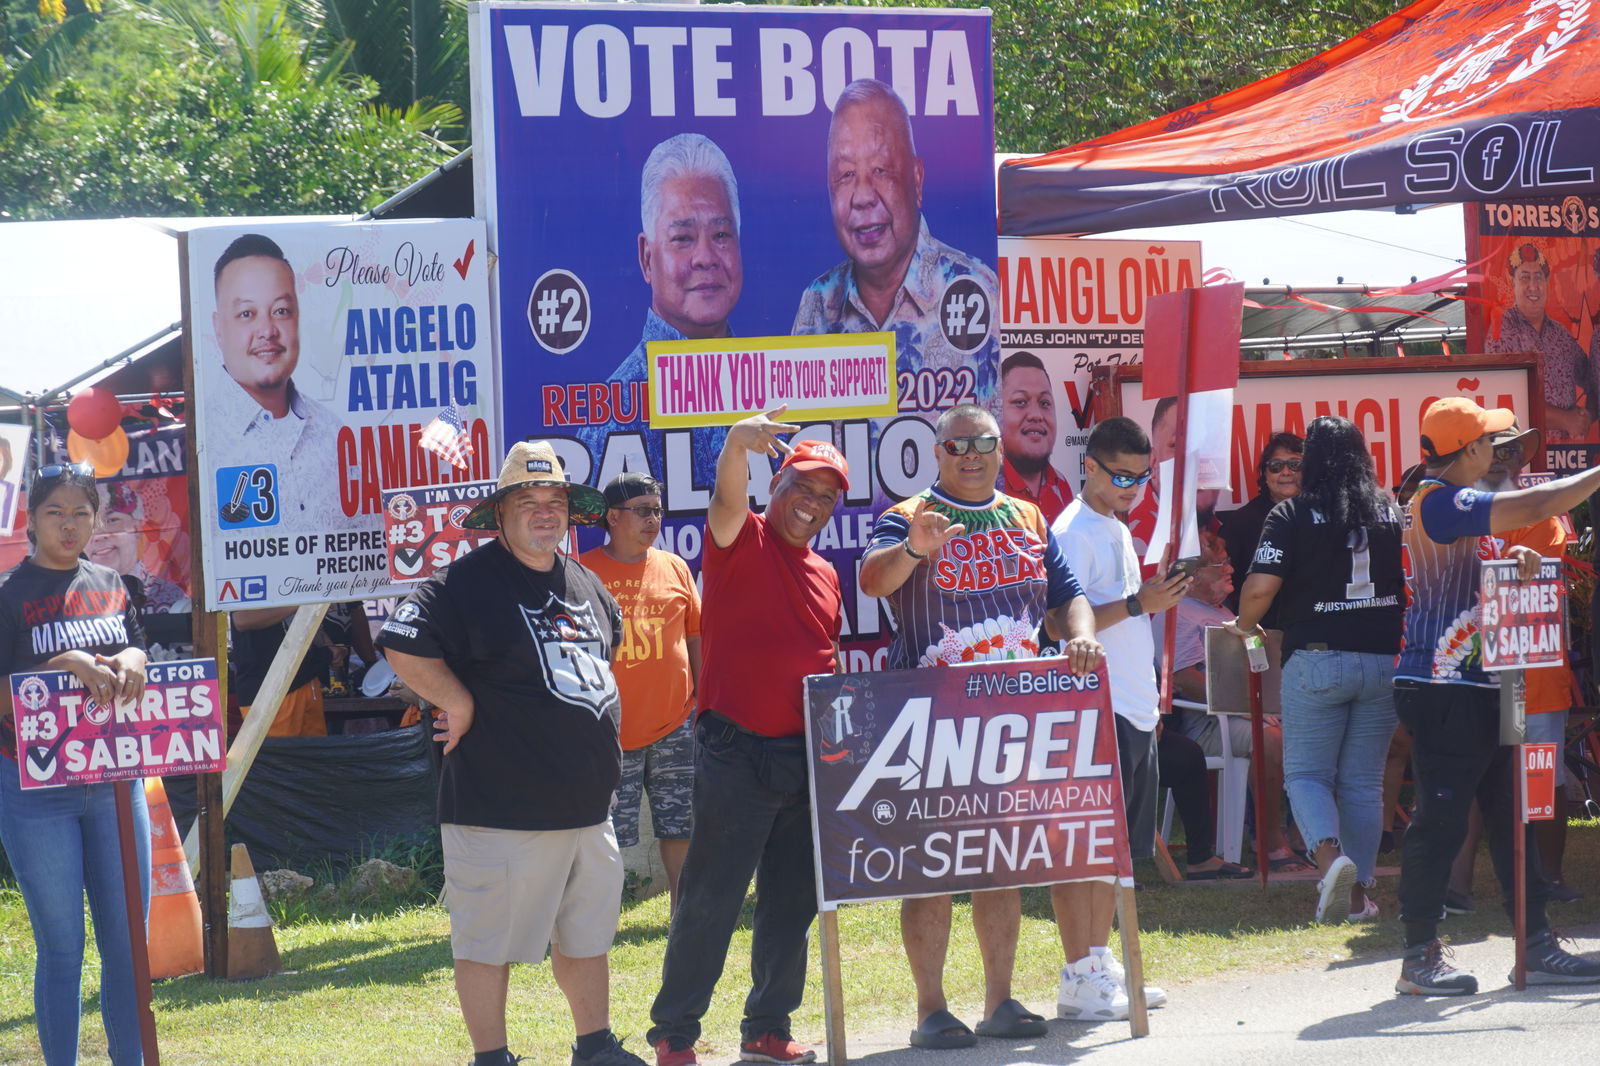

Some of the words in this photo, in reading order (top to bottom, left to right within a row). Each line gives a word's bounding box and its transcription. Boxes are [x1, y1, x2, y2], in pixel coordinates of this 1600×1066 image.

[504, 24, 737, 118] VOTE
[759, 27, 980, 116] BOTA
[1404, 121, 1595, 195] SOIL
[1486, 203, 1562, 228] TORRES
[325, 246, 390, 287] Please
[394, 241, 445, 286] Vote
[538, 288, 583, 335] #2
[946, 292, 986, 336] #2
[345, 303, 476, 355] ANGELO
[1046, 333, 1087, 345] JOHN
[347, 360, 477, 412] ATALIG
[658, 353, 723, 415] THANK
[726, 352, 767, 411] YOU
[770, 360, 794, 400] FOR
[794, 358, 826, 399] YOUR
[829, 356, 888, 396] SUPPORT!
[898, 368, 976, 411] 2022
[250, 468, 276, 522] 3
[425, 489, 450, 504] I'M
[225, 537, 289, 560] HOUSE
[295, 535, 319, 556] OF
[388, 521, 425, 545] #3
[316, 552, 387, 576] PRECINC
[1346, 526, 1375, 600] 1
[1541, 564, 1557, 580] FOR
[277, 577, 321, 597] Thank
[323, 577, 348, 596] you
[351, 575, 368, 597] for
[1483, 599, 1499, 626] #3
[1500, 623, 1561, 656] SABLAN
[58, 674, 86, 691] I'M
[168, 665, 206, 682] FOR
[966, 671, 1100, 697] #WeBelieve
[20, 711, 59, 741] #3
[65, 729, 221, 773] SABLAN
[1525, 748, 1554, 770] OÑA
[66, 774, 81, 782] PAID
[81, 773, 94, 781] FOR
[95, 772, 103, 780] BY
[103, 769, 139, 778] COMMITTEE
[150, 766, 169, 774] ELECT
[169, 764, 194, 772] TORRES
[194, 762, 219, 770] SABLAN
[907, 792, 989, 820] ALDAN
[998, 784, 1112, 815] DEMAPAN
[848, 838, 917, 884] for
[922, 819, 1116, 879] SENATE
